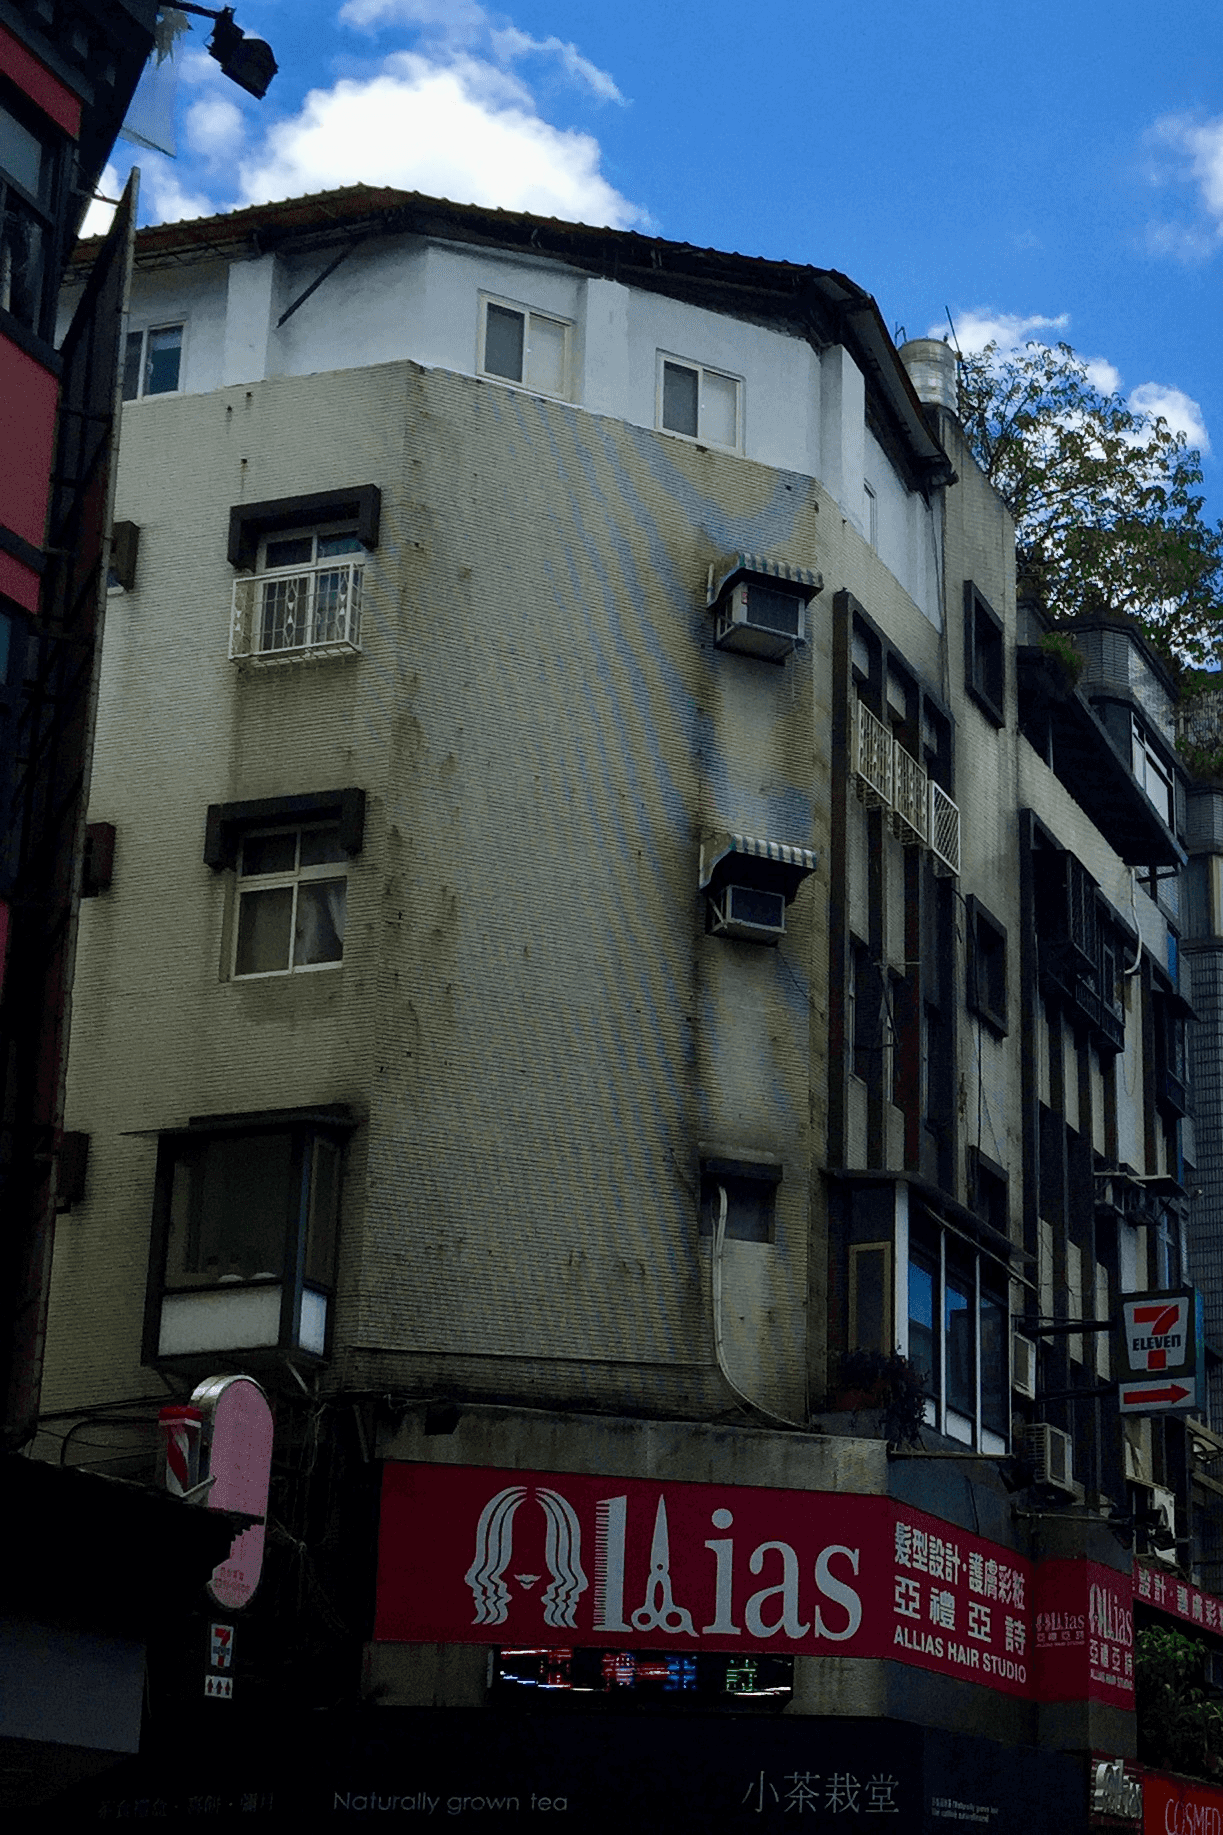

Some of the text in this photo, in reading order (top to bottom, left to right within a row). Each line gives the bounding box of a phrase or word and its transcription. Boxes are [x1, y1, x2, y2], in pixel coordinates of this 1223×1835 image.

[893, 1574, 1027, 1656] 亞禮亞詩
[893, 1624, 1027, 1684] ALLIAS HAIR STUDIO
[332, 1791, 568, 1816] Naturally grown tea
[741, 1770, 899, 1813] 小茶栽堂
